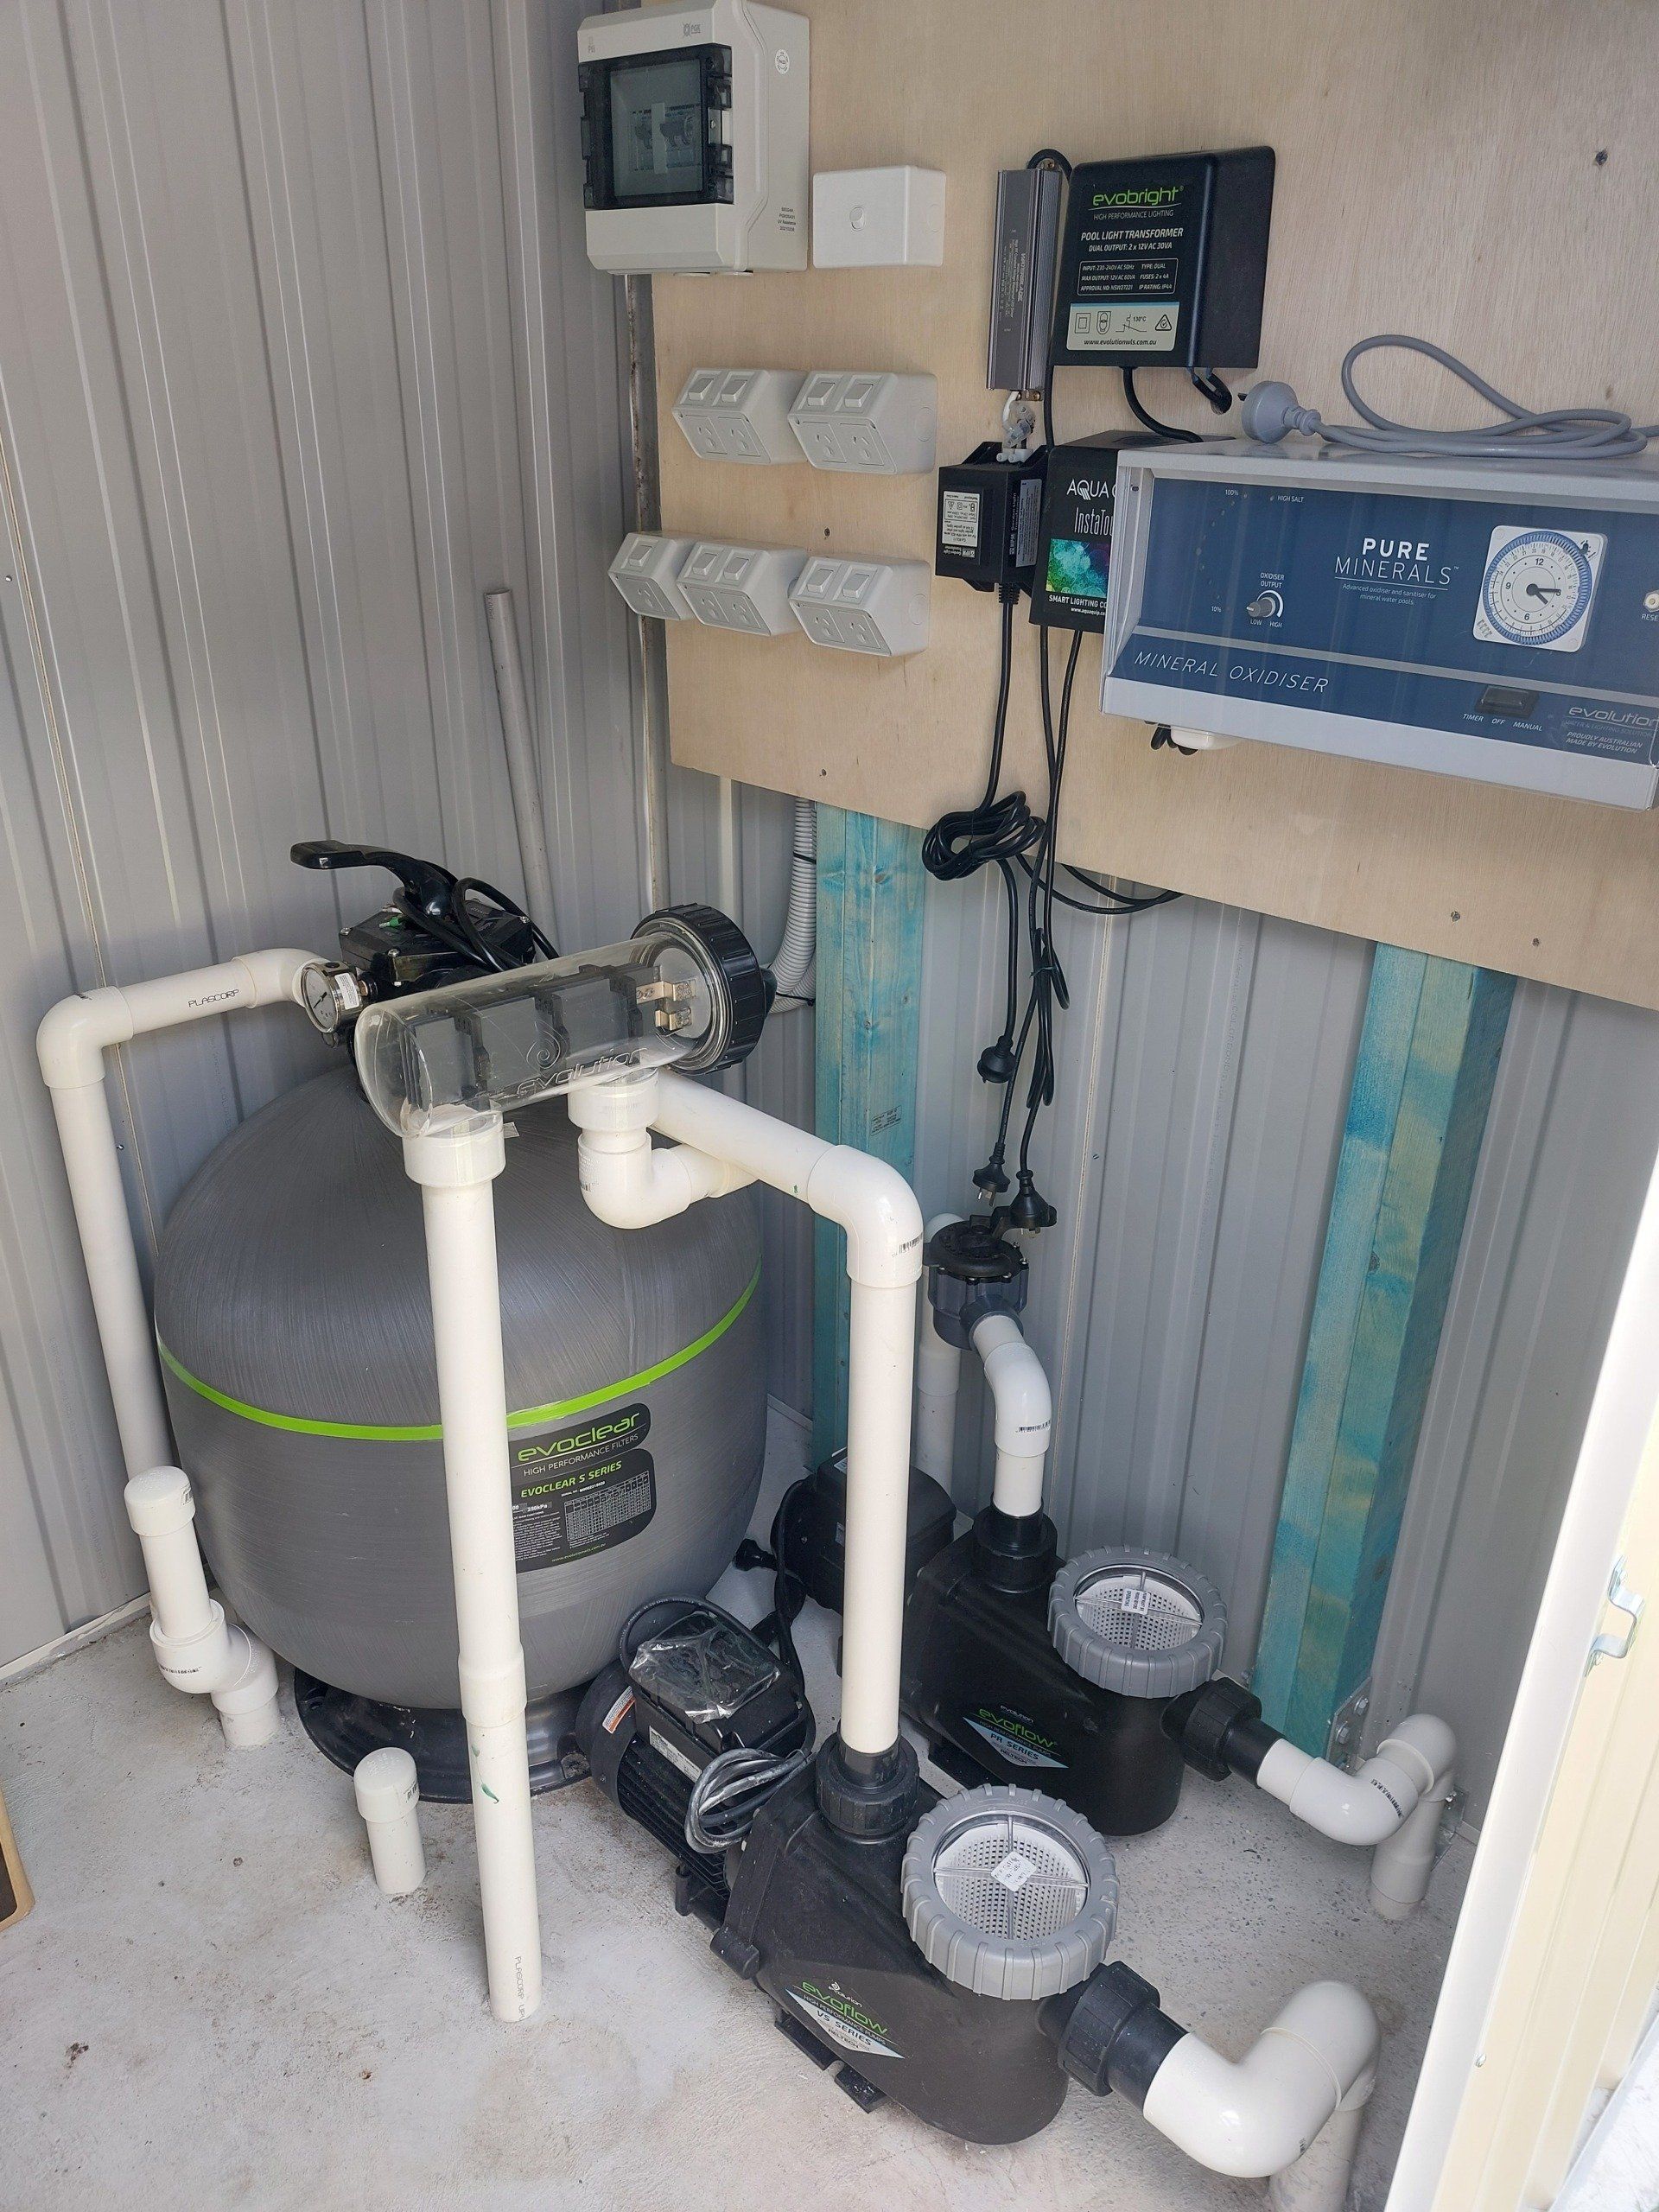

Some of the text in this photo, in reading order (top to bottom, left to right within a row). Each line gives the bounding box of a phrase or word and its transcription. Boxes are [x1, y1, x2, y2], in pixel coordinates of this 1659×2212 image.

[1092, 186, 1179, 206] evobright
[1108, 211, 1147, 219] PERFORMANCE
[1148, 209, 1173, 218] LIGHTING
[1081, 227, 1184, 241] POOL LIGHT TRANSFORMER
[1066, 479, 1109, 500] AQUA
[1362, 537, 1430, 562] PURE
[1335, 556, 1452, 585] MINERALS
[1048, 594, 1070, 604] SMART
[1071, 597, 1098, 607] LIGHTING
[1343, 583, 1369, 592] Advanced
[1370, 586, 1390, 594] oxidiser
[1403, 589, 1427, 598] sanitiser
[1134, 651, 1329, 693] MINERAL OXIDISER
[1462, 713, 1484, 722] TIMER
[1512, 721, 1542, 732] MANUAL
[1566, 738, 1586, 747] MADE
[1598, 743, 1637, 754] EVOLUTION
[1567, 731, 1643, 748] PROUDLY AUSTRALIAN
[188, 988, 239, 1007] PLASCORP
[518, 1412, 640, 1462] evoclear
[523, 1433, 639, 1477] HIGH PERFORMANCE FILTERS
[520, 1478, 576, 1498] EVOCLEAR
[579, 1474, 586, 1483] S
[588, 1460, 622, 1480] SERIES
[979, 1708, 1054, 1747] evoflow
[990, 1732, 1002, 1743] PR
[1007, 1741, 1039, 1760] SERIES
[802, 1981, 888, 2034] evoflow
[804, 1994, 818, 2006] HIGH
[820, 2003, 864, 2033] PERFORMANCE
[865, 2030, 887, 2045] PUMPS
[817, 2010, 830, 2022] VS
[835, 2020, 872, 2046] SERIES
